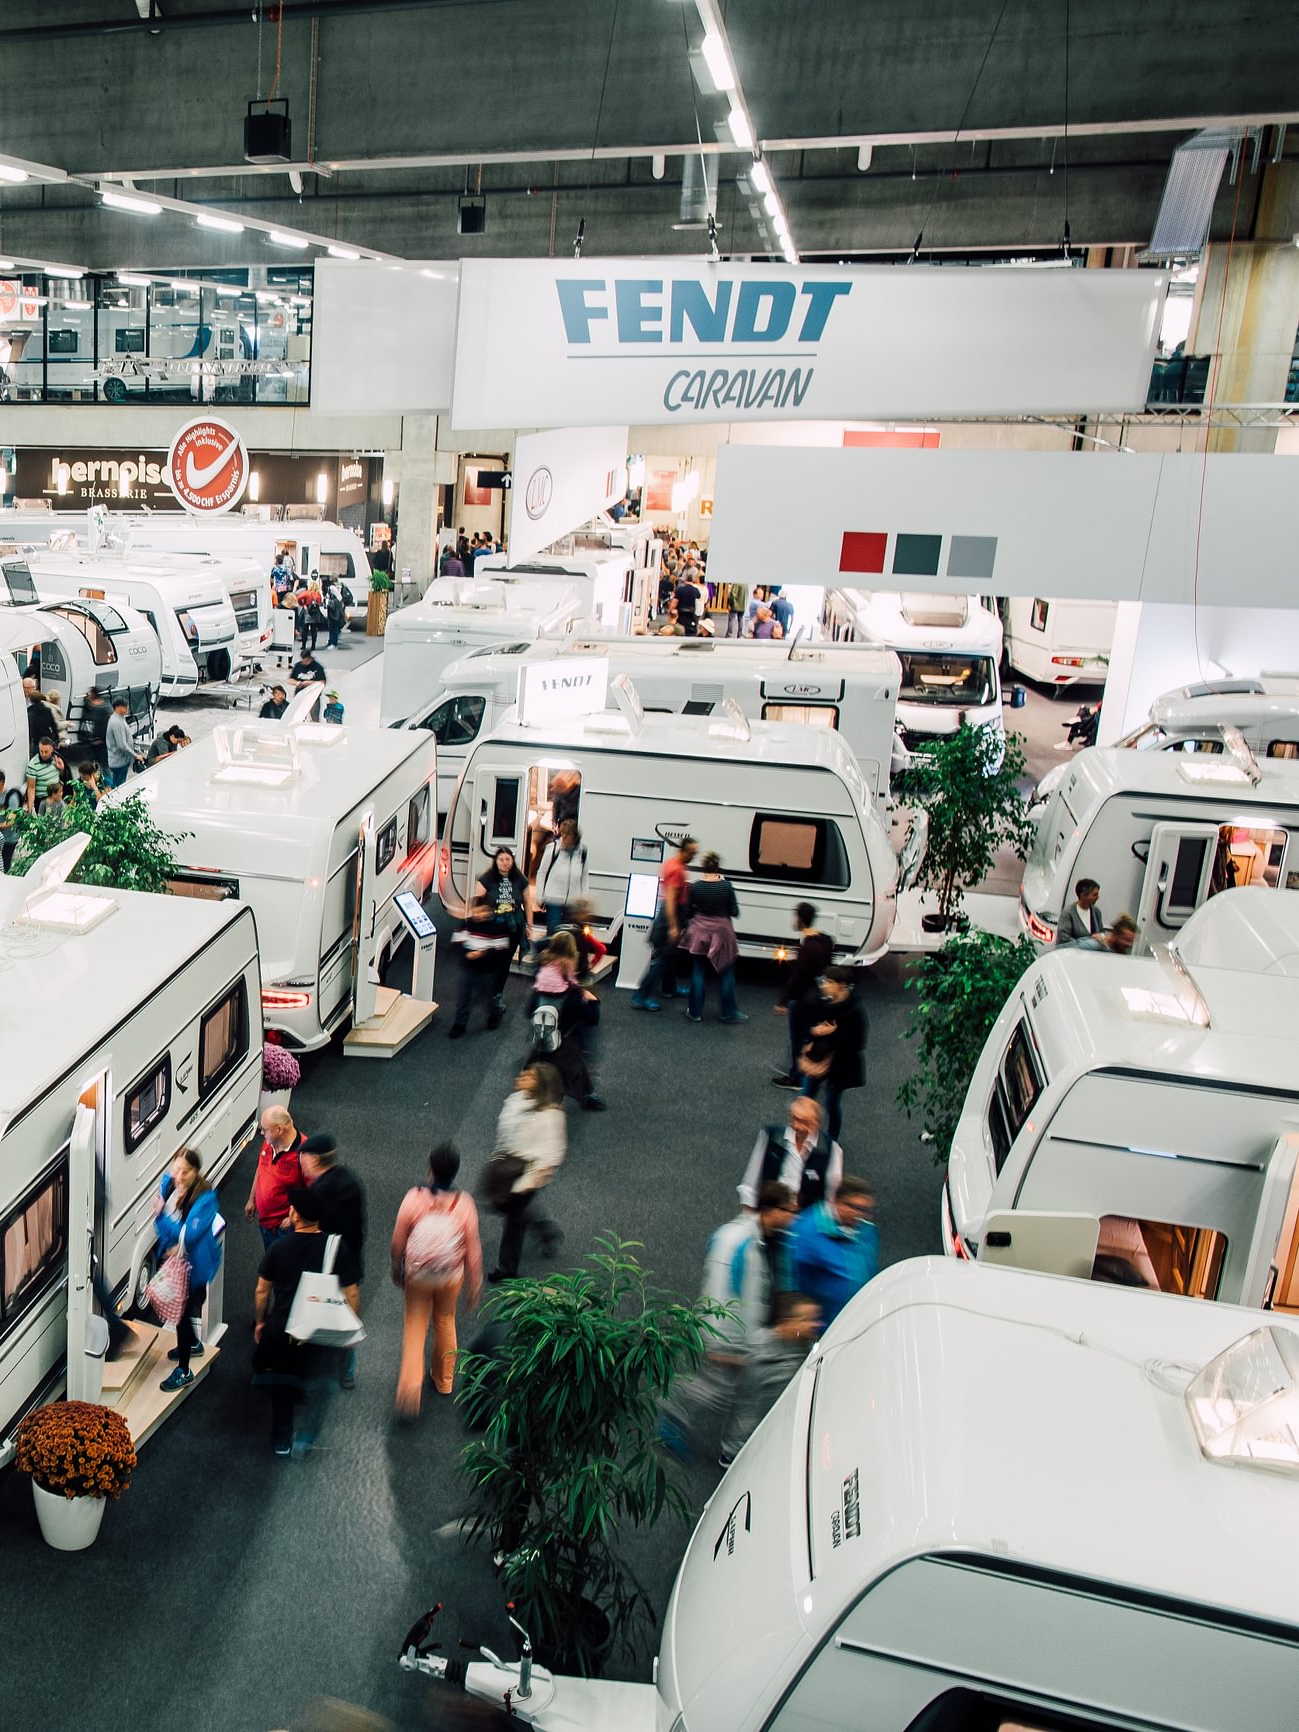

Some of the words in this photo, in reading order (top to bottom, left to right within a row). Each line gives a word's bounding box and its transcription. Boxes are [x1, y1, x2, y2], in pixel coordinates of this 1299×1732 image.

[556, 279, 853, 344] FENDT
[664, 367, 814, 412] CARAVAN
[177, 441, 187, 456] Alle
[185, 425, 216, 443] Highlights
[195, 436, 223, 451] inklusive
[80, 487, 147, 499] BRASSRIE
[183, 488, 201, 505] 4.500
[201, 497, 214, 507] CHF
[843, 1467, 861, 1540] FENDT
[830, 1509, 842, 1549] CARAVAN
